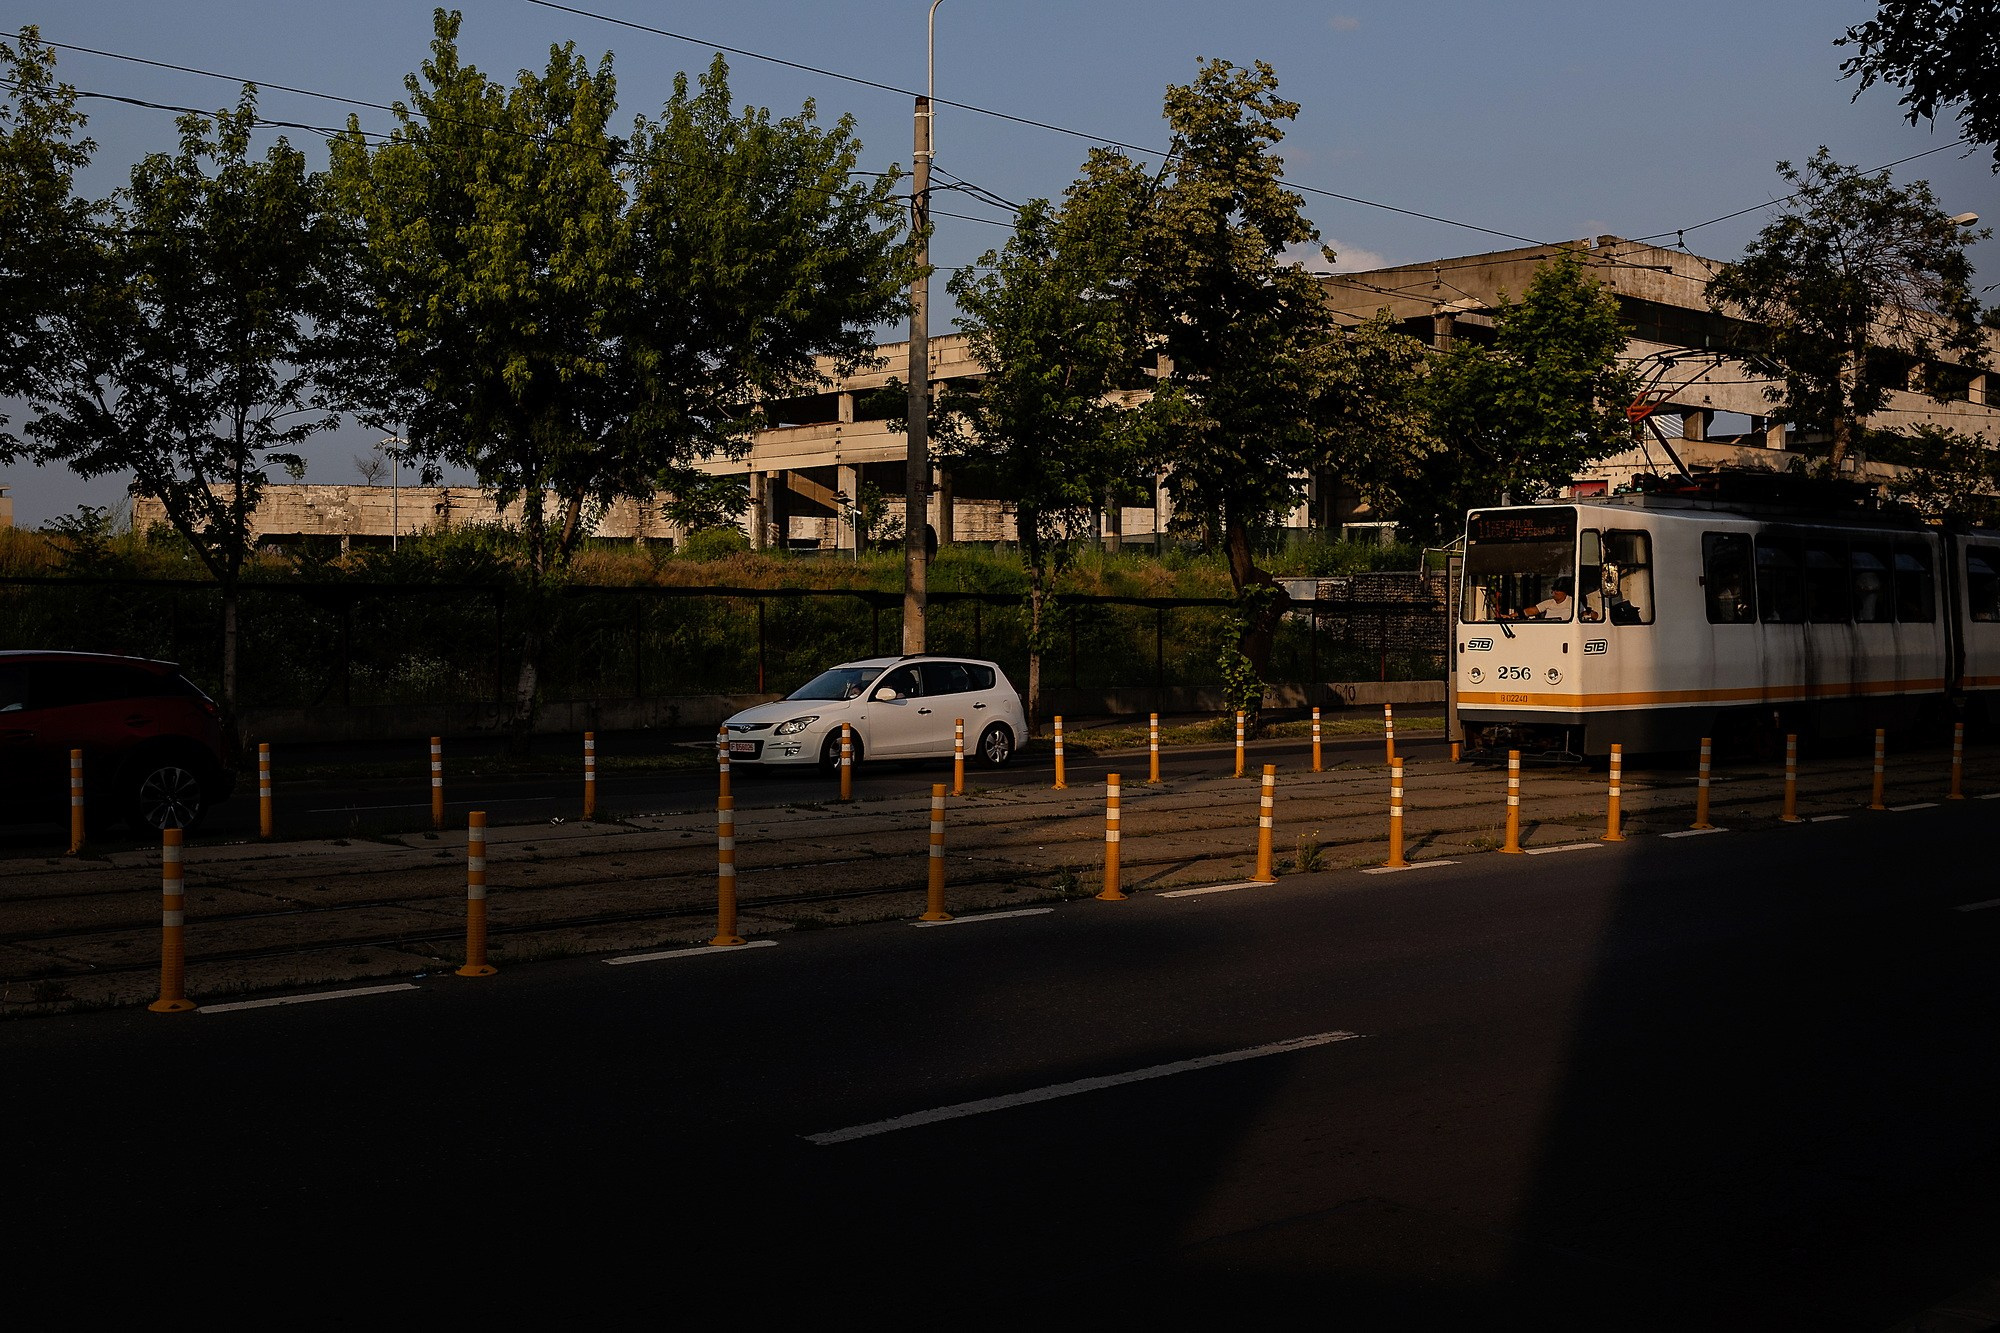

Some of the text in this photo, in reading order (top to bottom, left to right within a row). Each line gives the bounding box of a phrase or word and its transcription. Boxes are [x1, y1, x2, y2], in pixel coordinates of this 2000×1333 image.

[1468, 639, 1492, 649] STB
[1583, 641, 1606, 653] STB
[1497, 666, 1531, 680] 256
